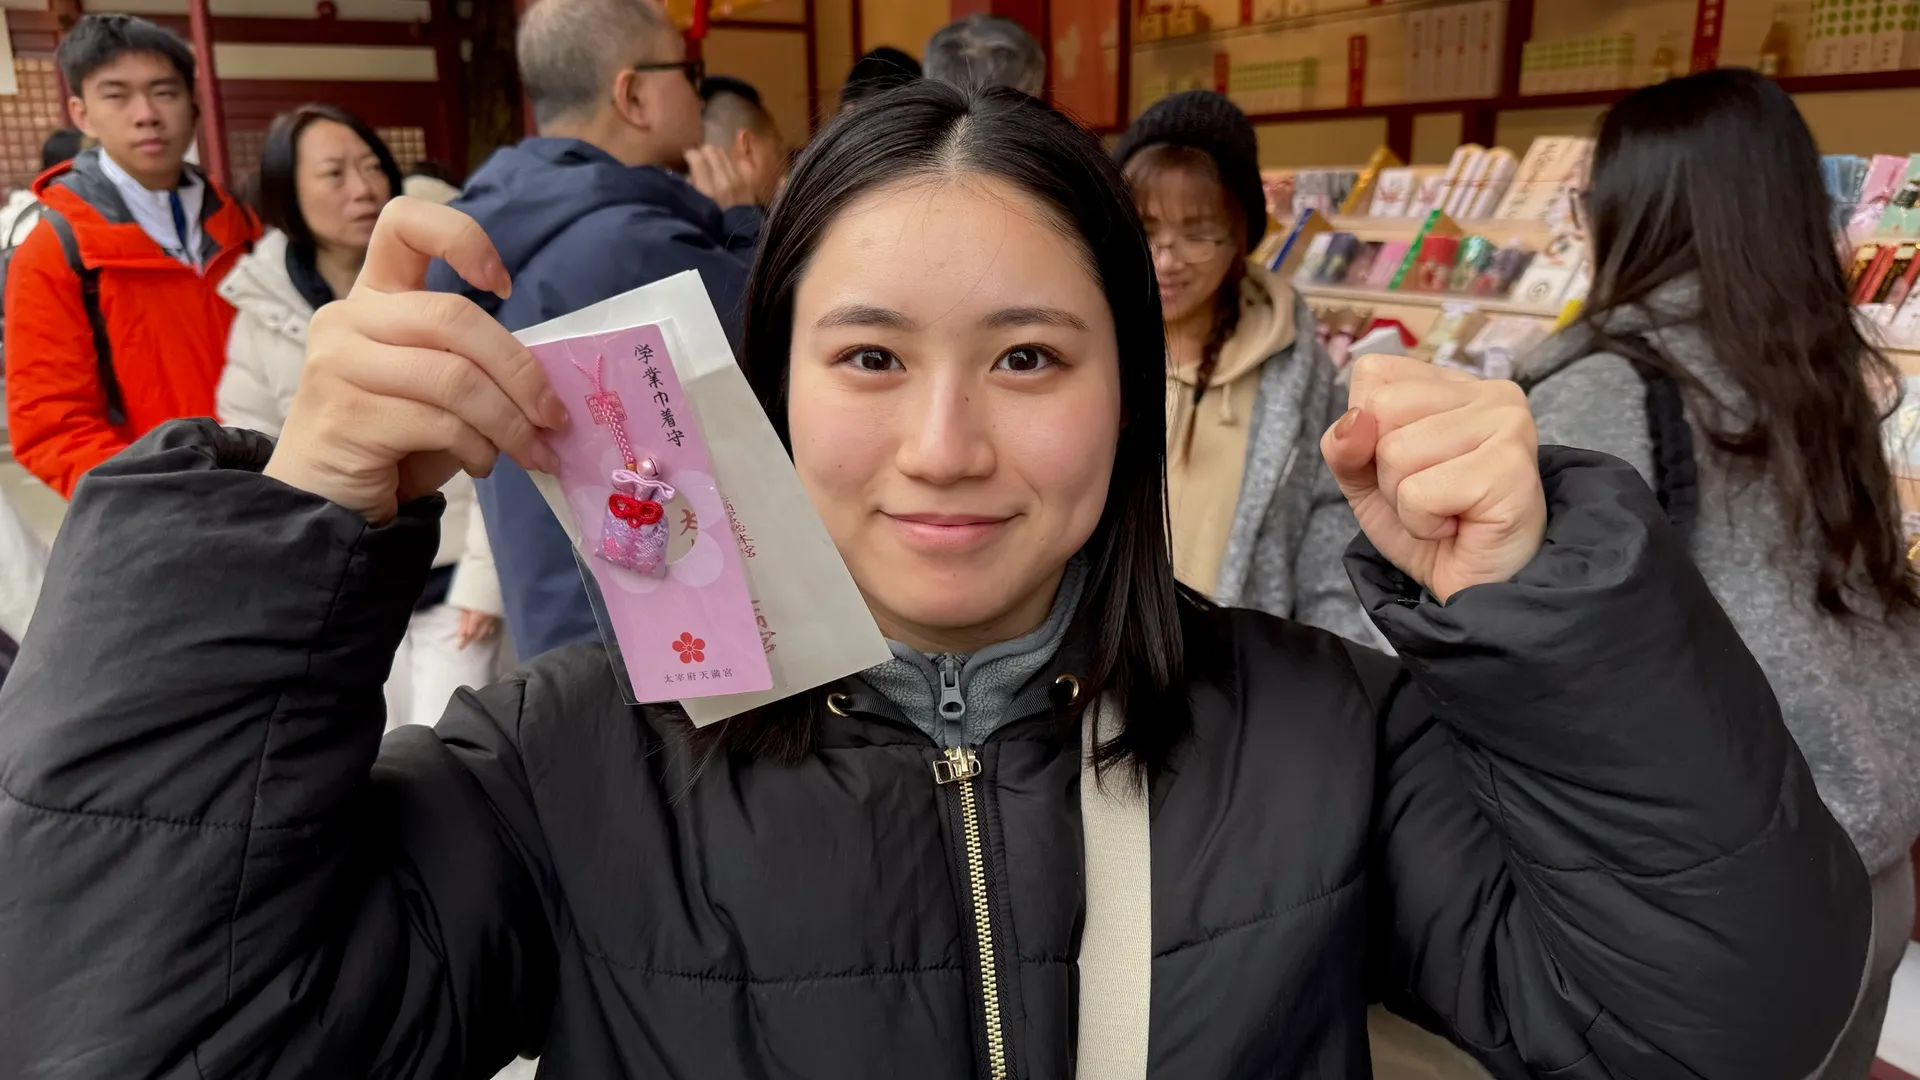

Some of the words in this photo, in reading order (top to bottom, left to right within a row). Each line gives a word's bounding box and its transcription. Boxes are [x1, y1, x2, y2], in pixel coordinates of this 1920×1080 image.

[635, 344, 685, 447] 学業巾着守
[664, 668, 733, 684] 太宰府天満宮
